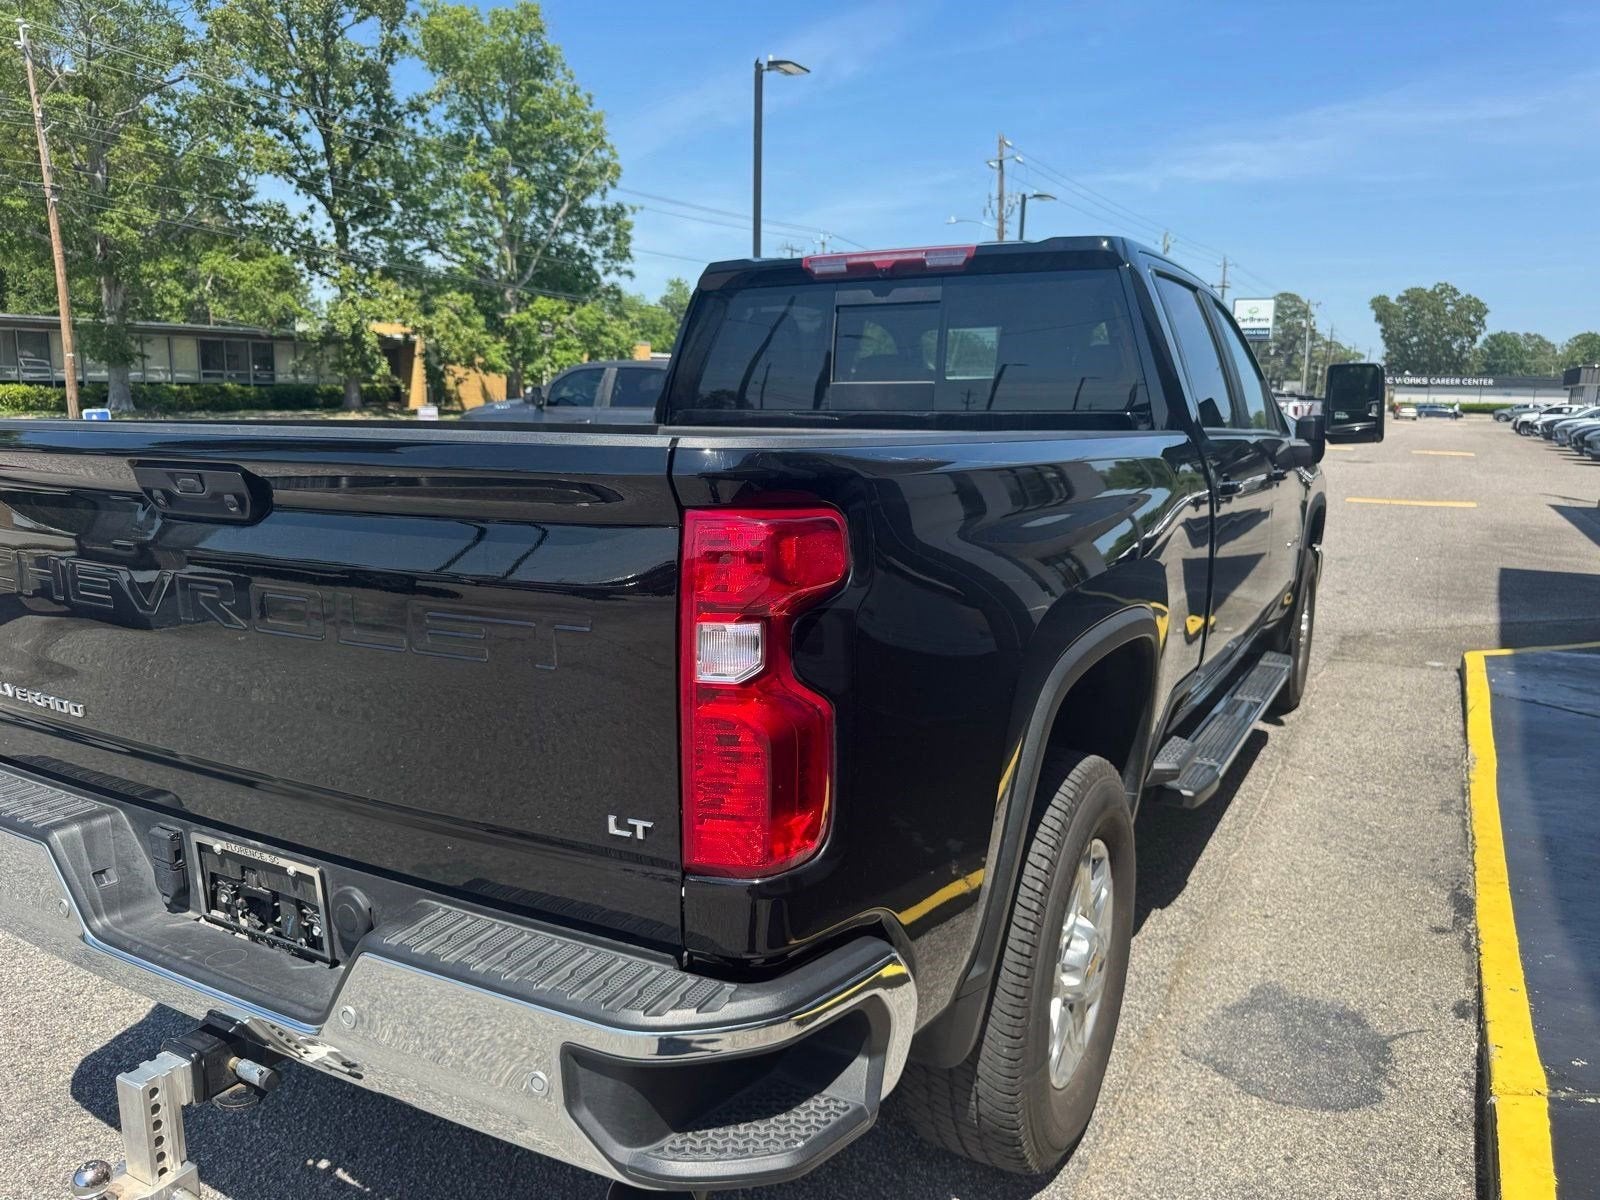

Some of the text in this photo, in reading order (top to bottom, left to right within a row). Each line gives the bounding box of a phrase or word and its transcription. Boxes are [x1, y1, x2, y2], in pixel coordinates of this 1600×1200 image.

[1395, 376, 1428, 385] WORKS
[1429, 377, 1460, 386] CAREER
[1461, 377, 1494, 386] CENTER
[608, 814, 655, 840] LT
